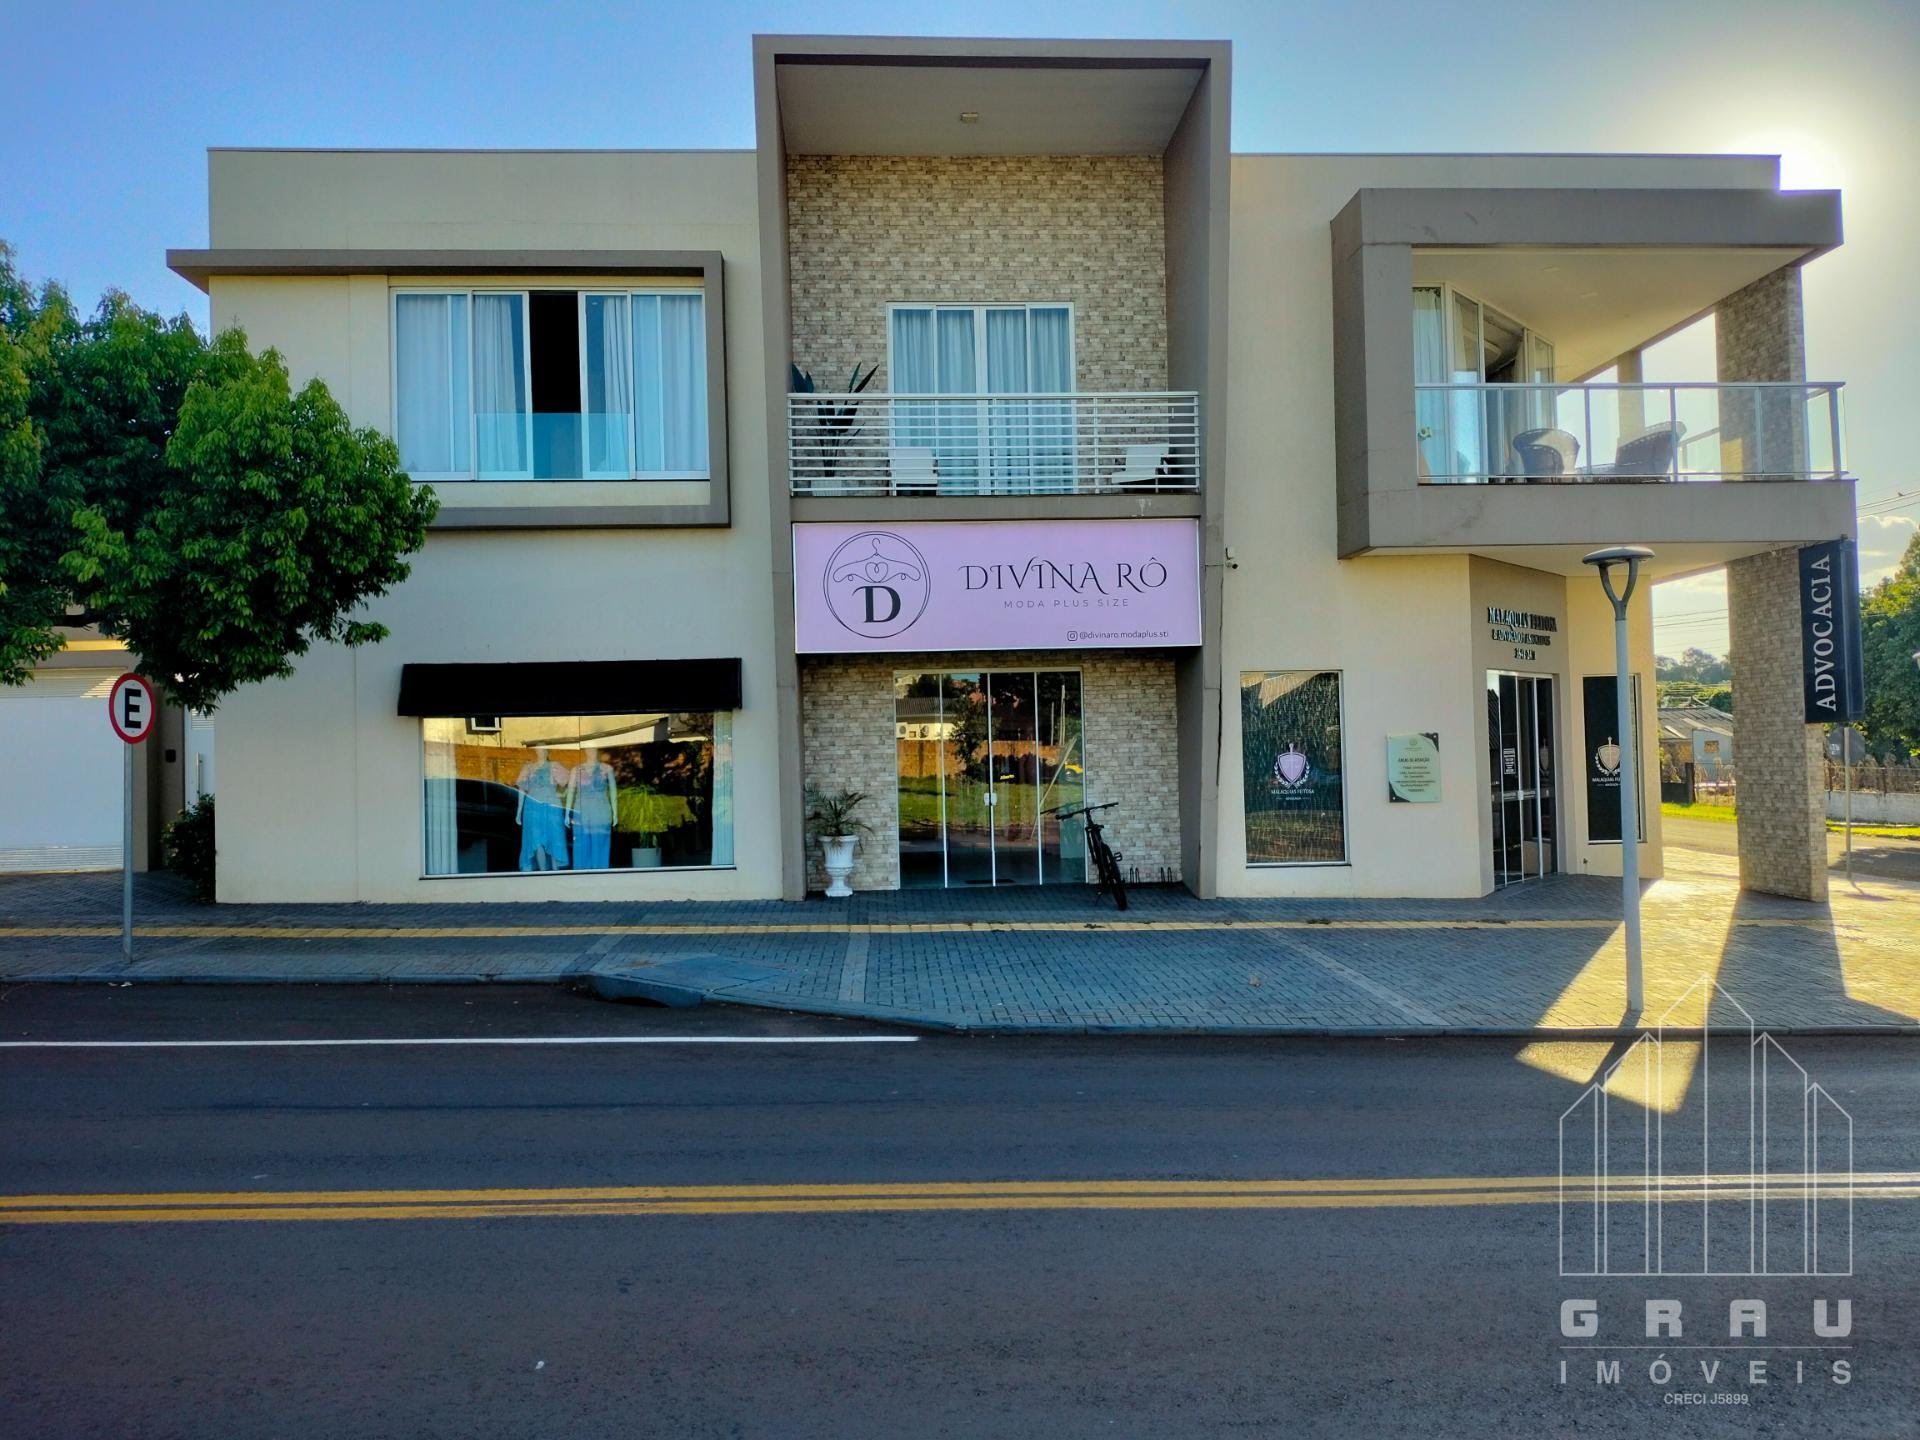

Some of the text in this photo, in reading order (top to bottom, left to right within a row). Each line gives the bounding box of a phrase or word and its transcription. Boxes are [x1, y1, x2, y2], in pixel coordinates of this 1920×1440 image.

[958, 555, 1168, 595] DIVINA RÔ
[851, 585, 902, 624] D
[1003, 598, 1130, 609] MODA PLUS SIZE
[1810, 553, 1837, 712] ADVOCACIA
[124, 687, 142, 729] E
